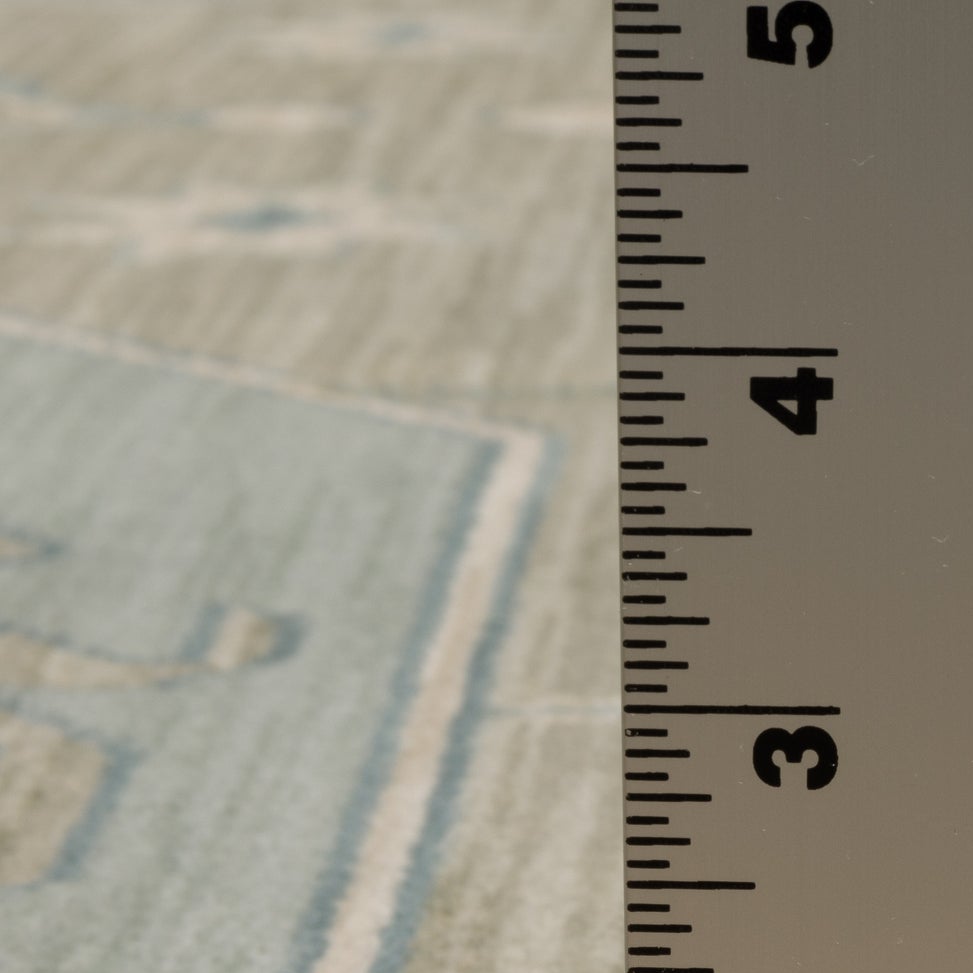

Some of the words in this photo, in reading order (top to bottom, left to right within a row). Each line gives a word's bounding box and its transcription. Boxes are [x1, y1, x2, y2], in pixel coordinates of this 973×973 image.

[746, 0, 834, 69] 5
[750, 367, 834, 435] 4
[753, 726, 838, 790] 3
